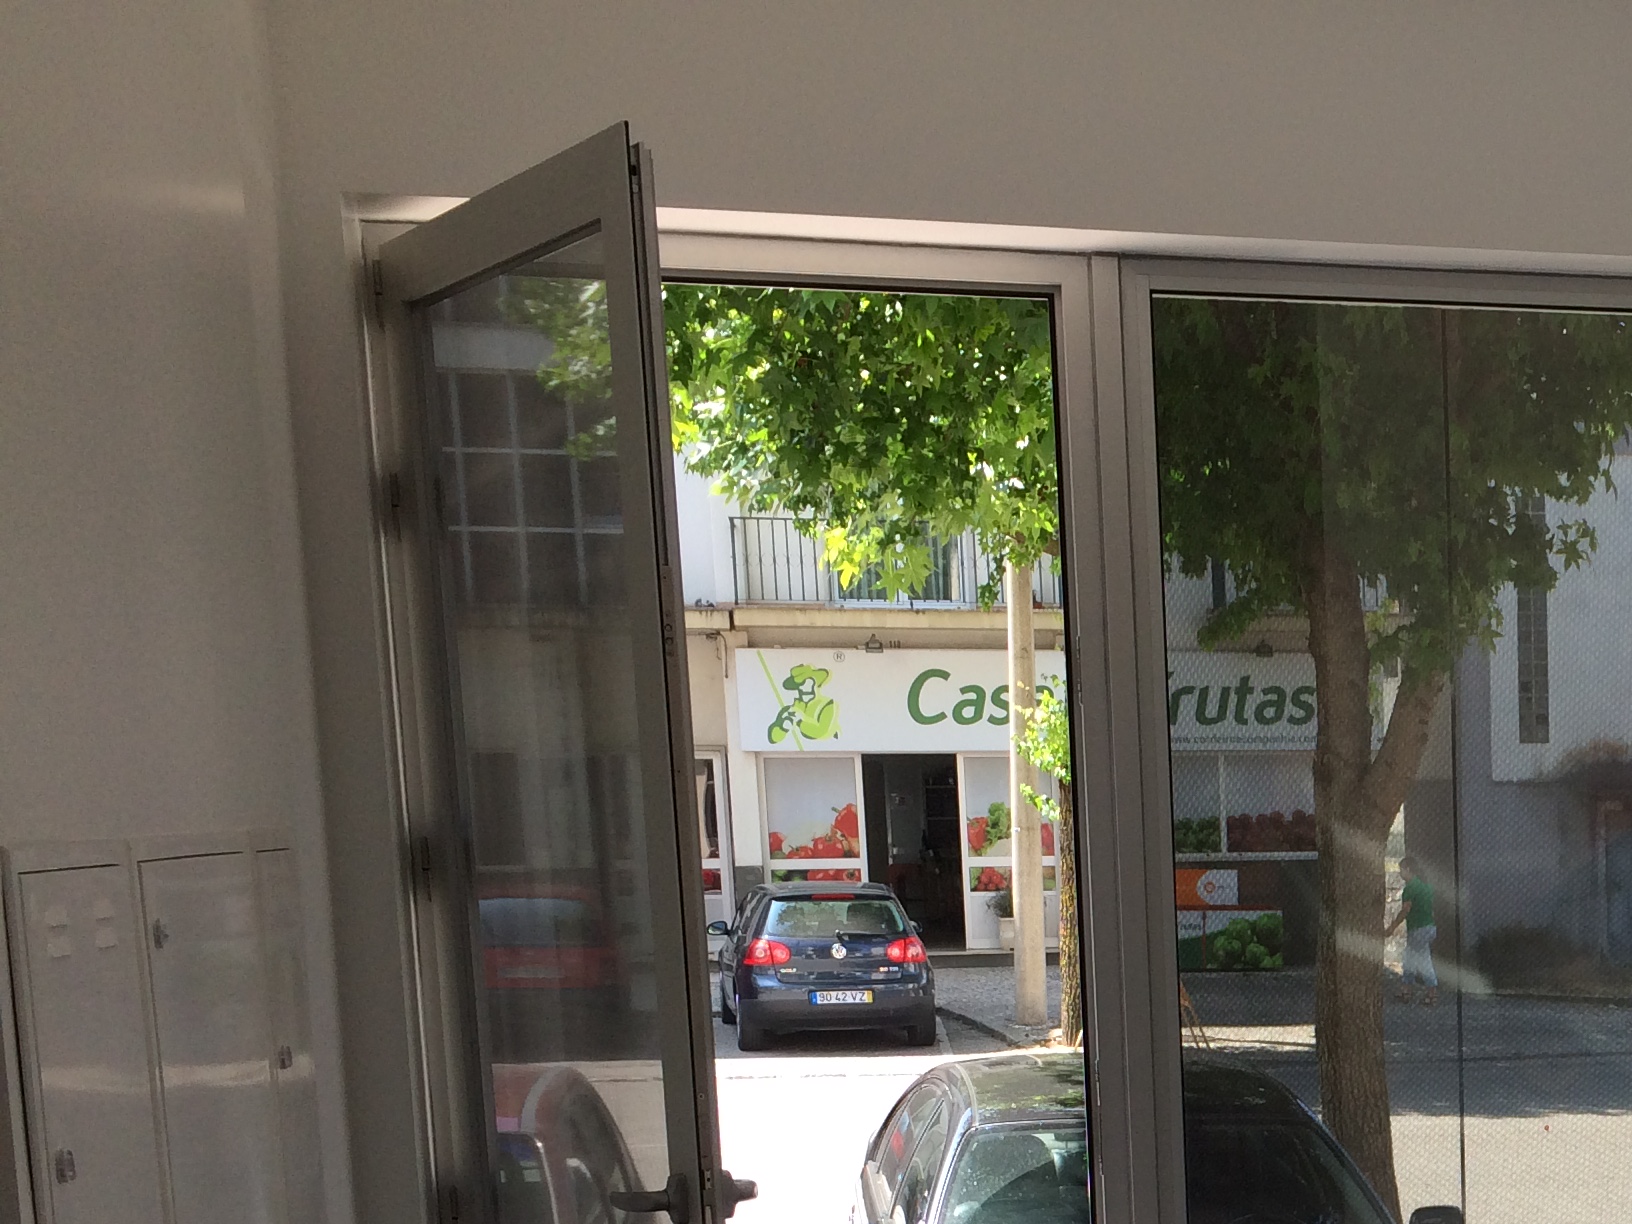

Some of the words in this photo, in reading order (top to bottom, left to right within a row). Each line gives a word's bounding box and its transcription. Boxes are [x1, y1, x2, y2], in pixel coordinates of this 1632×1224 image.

[907, 668, 1054, 726] Cas
[1168, 671, 1318, 726] rutas
[818, 992, 832, 1002] 90
[835, 992, 848, 1002] 42
[850, 991, 867, 1002] VZ
